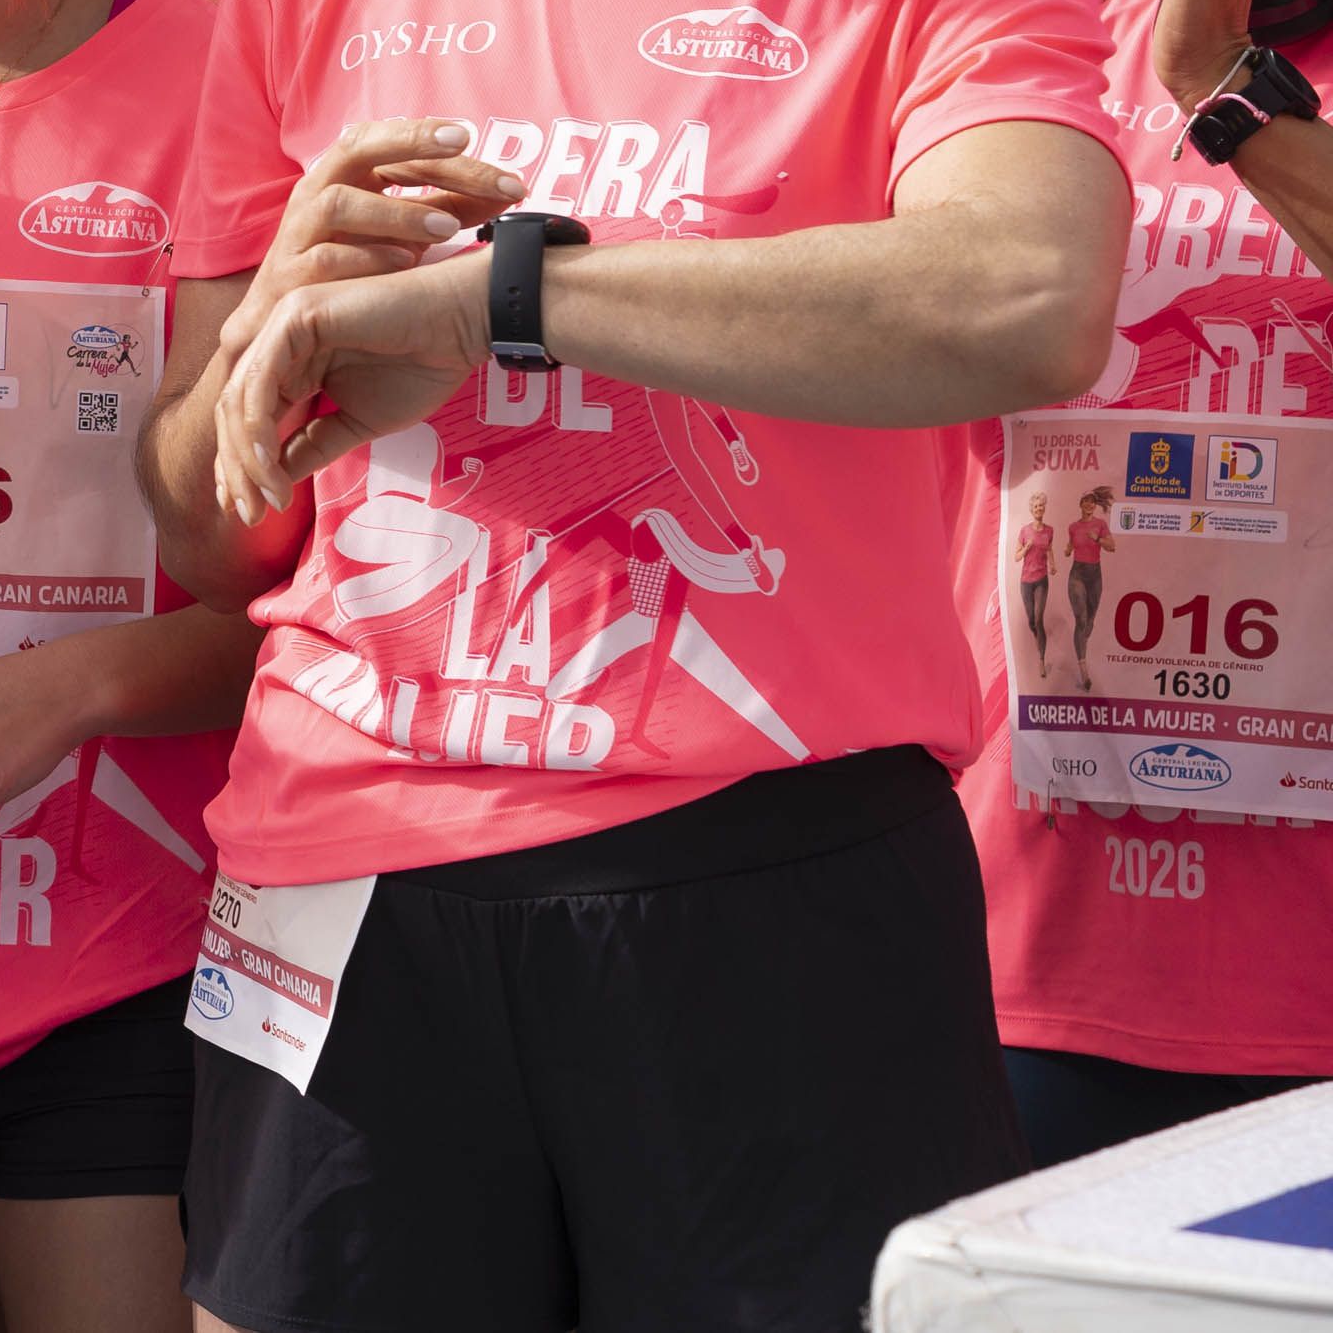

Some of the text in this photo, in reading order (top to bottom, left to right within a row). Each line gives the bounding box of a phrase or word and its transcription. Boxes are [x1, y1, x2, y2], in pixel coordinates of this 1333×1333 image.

[341, 19, 496, 70] OYSHO
[649, 27, 793, 72] ASTURIANA
[681, 28, 793, 50] CENTRAL LECHERA
[29, 204, 157, 243] ASTURIANA
[55, 205, 103, 215] CENTRAL
[1033, 434, 1101, 448] TU DORSAL
[1034, 450, 1099, 471] SUMA
[1131, 485, 1185, 495] Gran Canaria
[1134, 477, 1181, 486] Cabildo de
[38, 585, 128, 605] CANARIA
[441, 525, 552, 685] LA
[1114, 591, 1279, 660] 016
[1106, 654, 1153, 664] TELÉFONO
[1156, 657, 1206, 668] VIOLENCIA
[1223, 661, 1263, 672] GÉNERO
[1154, 669, 1230, 700] 1630
[1028, 704, 1088, 725] CARRERA
[1091, 706, 1108, 726] DE
[1113, 707, 1135, 728] LA
[1144, 709, 1215, 733] MUJER
[1237, 717, 1294, 739] GRAN
[1136, 758, 1223, 782] ASTURIANA
[1105, 836, 1205, 900] 2026
[213, 888, 241, 928] 2270
[205, 928, 321, 1007] MUJER GRAN CANARIA
[271, 1023, 307, 1051] Santander
